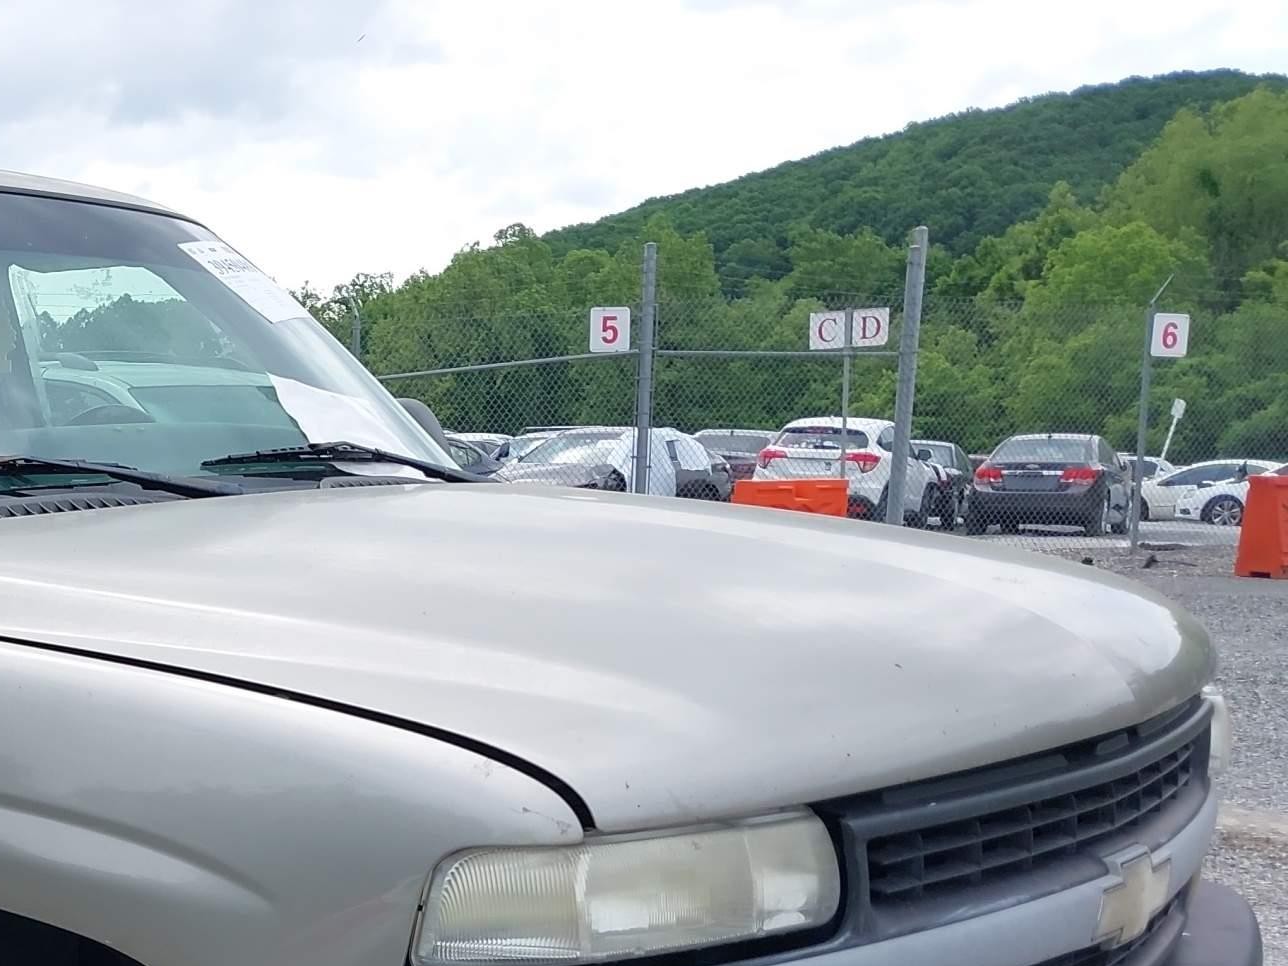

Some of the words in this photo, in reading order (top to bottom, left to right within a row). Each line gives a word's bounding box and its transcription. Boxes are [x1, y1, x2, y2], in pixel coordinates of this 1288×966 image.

[601, 315, 619, 344] 5
[817, 318, 838, 343] C
[860, 315, 882, 340] D
[1162, 322, 1179, 349] 6
